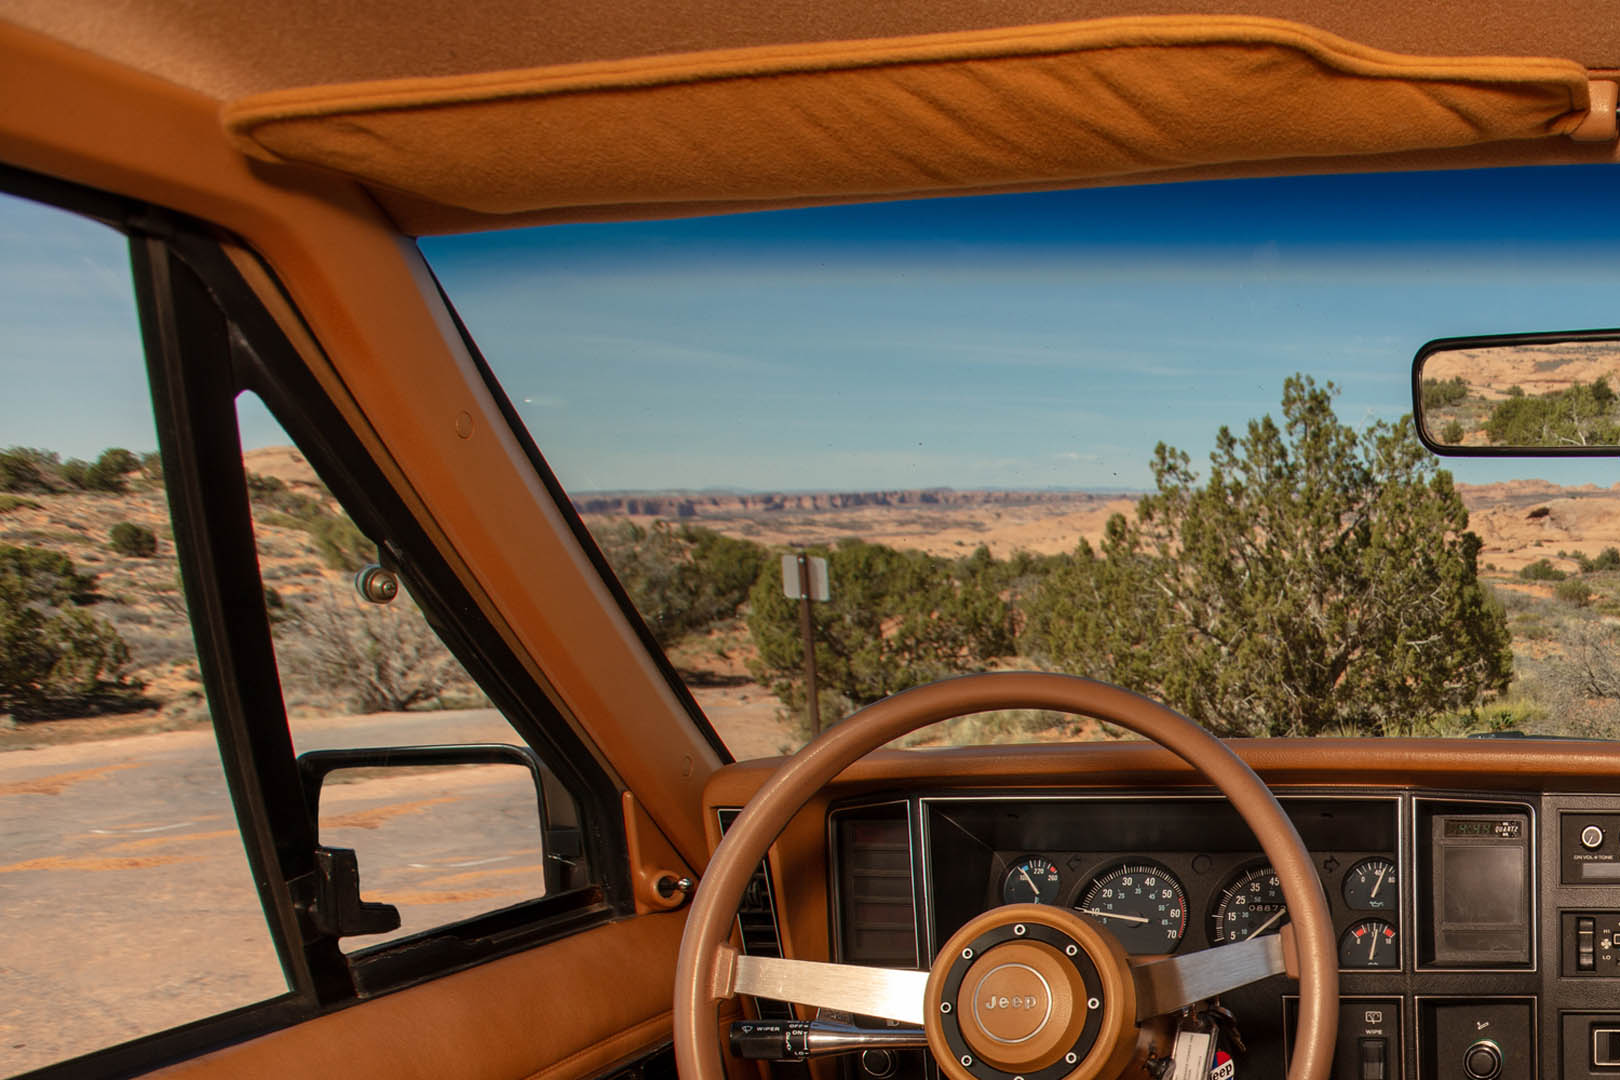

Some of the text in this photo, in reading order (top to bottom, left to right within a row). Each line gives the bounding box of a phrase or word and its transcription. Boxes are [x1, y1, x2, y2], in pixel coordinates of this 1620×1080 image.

[1122, 878, 1133, 886] 30
[1145, 878, 1155, 886] 40
[1269, 877, 1280, 886] 45
[1250, 884, 1260, 892] 35
[1102, 889, 1113, 898] 20
[1162, 889, 1172, 898] 50
[1236, 896, 1246, 904] 25
[1170, 909, 1181, 918] 60
[1228, 912, 1236, 921] 15
[1167, 930, 1177, 939] 70
[1230, 932, 1236, 940] 5
[985, 995, 1037, 1009] Jeep
